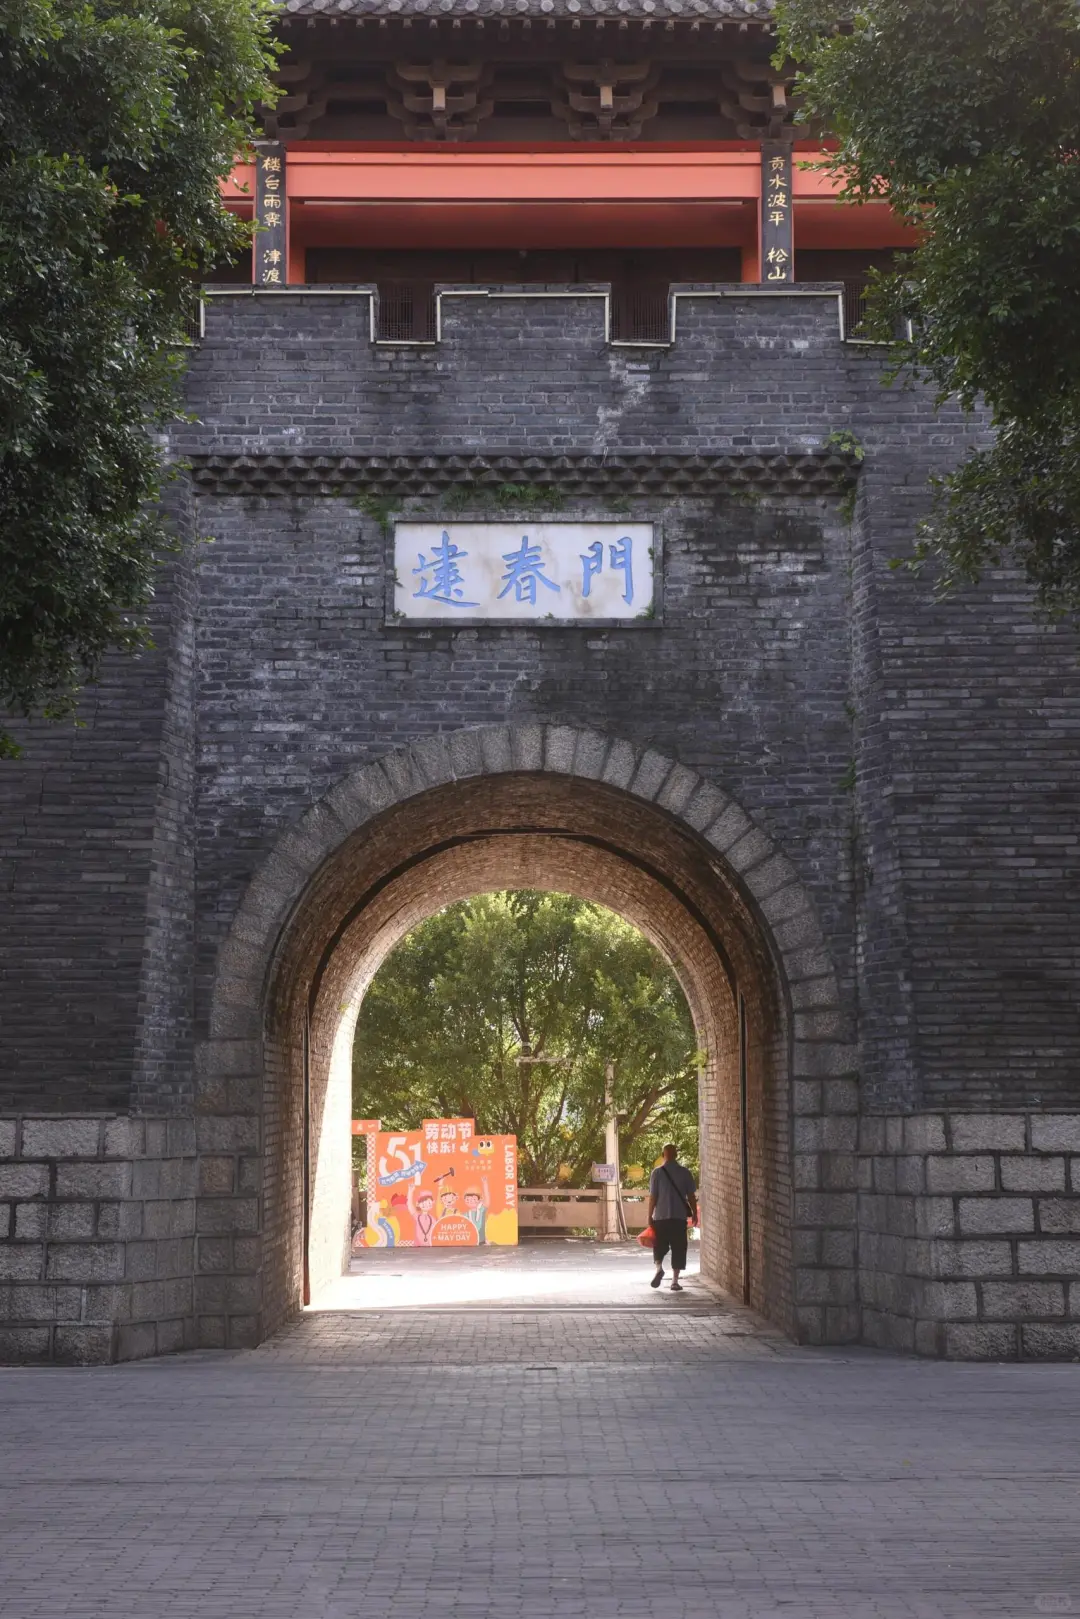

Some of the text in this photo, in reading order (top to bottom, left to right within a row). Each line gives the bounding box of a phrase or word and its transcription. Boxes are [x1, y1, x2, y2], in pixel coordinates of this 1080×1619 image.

[766, 156, 788, 280] 贡水波平 松山
[425, 1122, 472, 1140] 劳动节
[378, 1136, 422, 1186] 51
[504, 1144, 516, 1208] LABOR DAY
